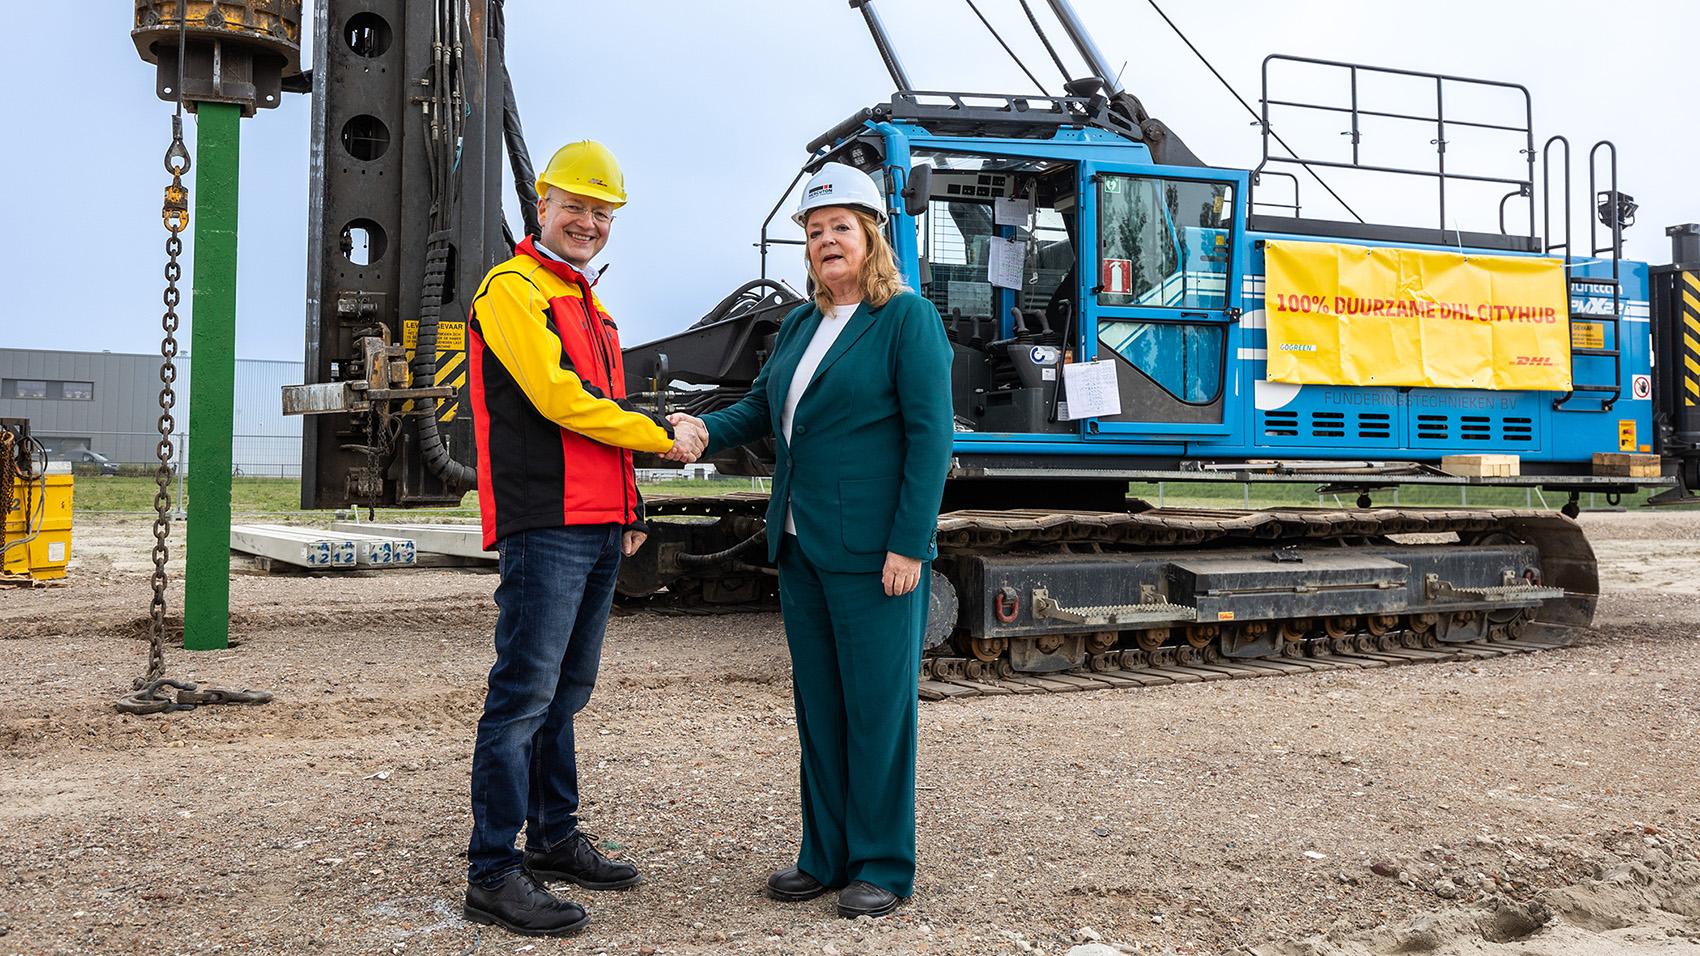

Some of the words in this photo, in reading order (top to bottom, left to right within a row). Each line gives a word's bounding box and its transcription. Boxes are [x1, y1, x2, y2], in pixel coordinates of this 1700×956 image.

[1277, 293, 1329, 314] 100%
[1334, 296, 1435, 319] DUURZAME
[1440, 302, 1475, 321] DHL
[1477, 304, 1557, 324] CITYHUB
[1280, 343, 1312, 351] GOGREEN
[1516, 356, 1553, 366] DHL
[1324, 391, 1496, 409] FUNDERINGSTECHNIEKEN
[1501, 398, 1518, 410] BV
